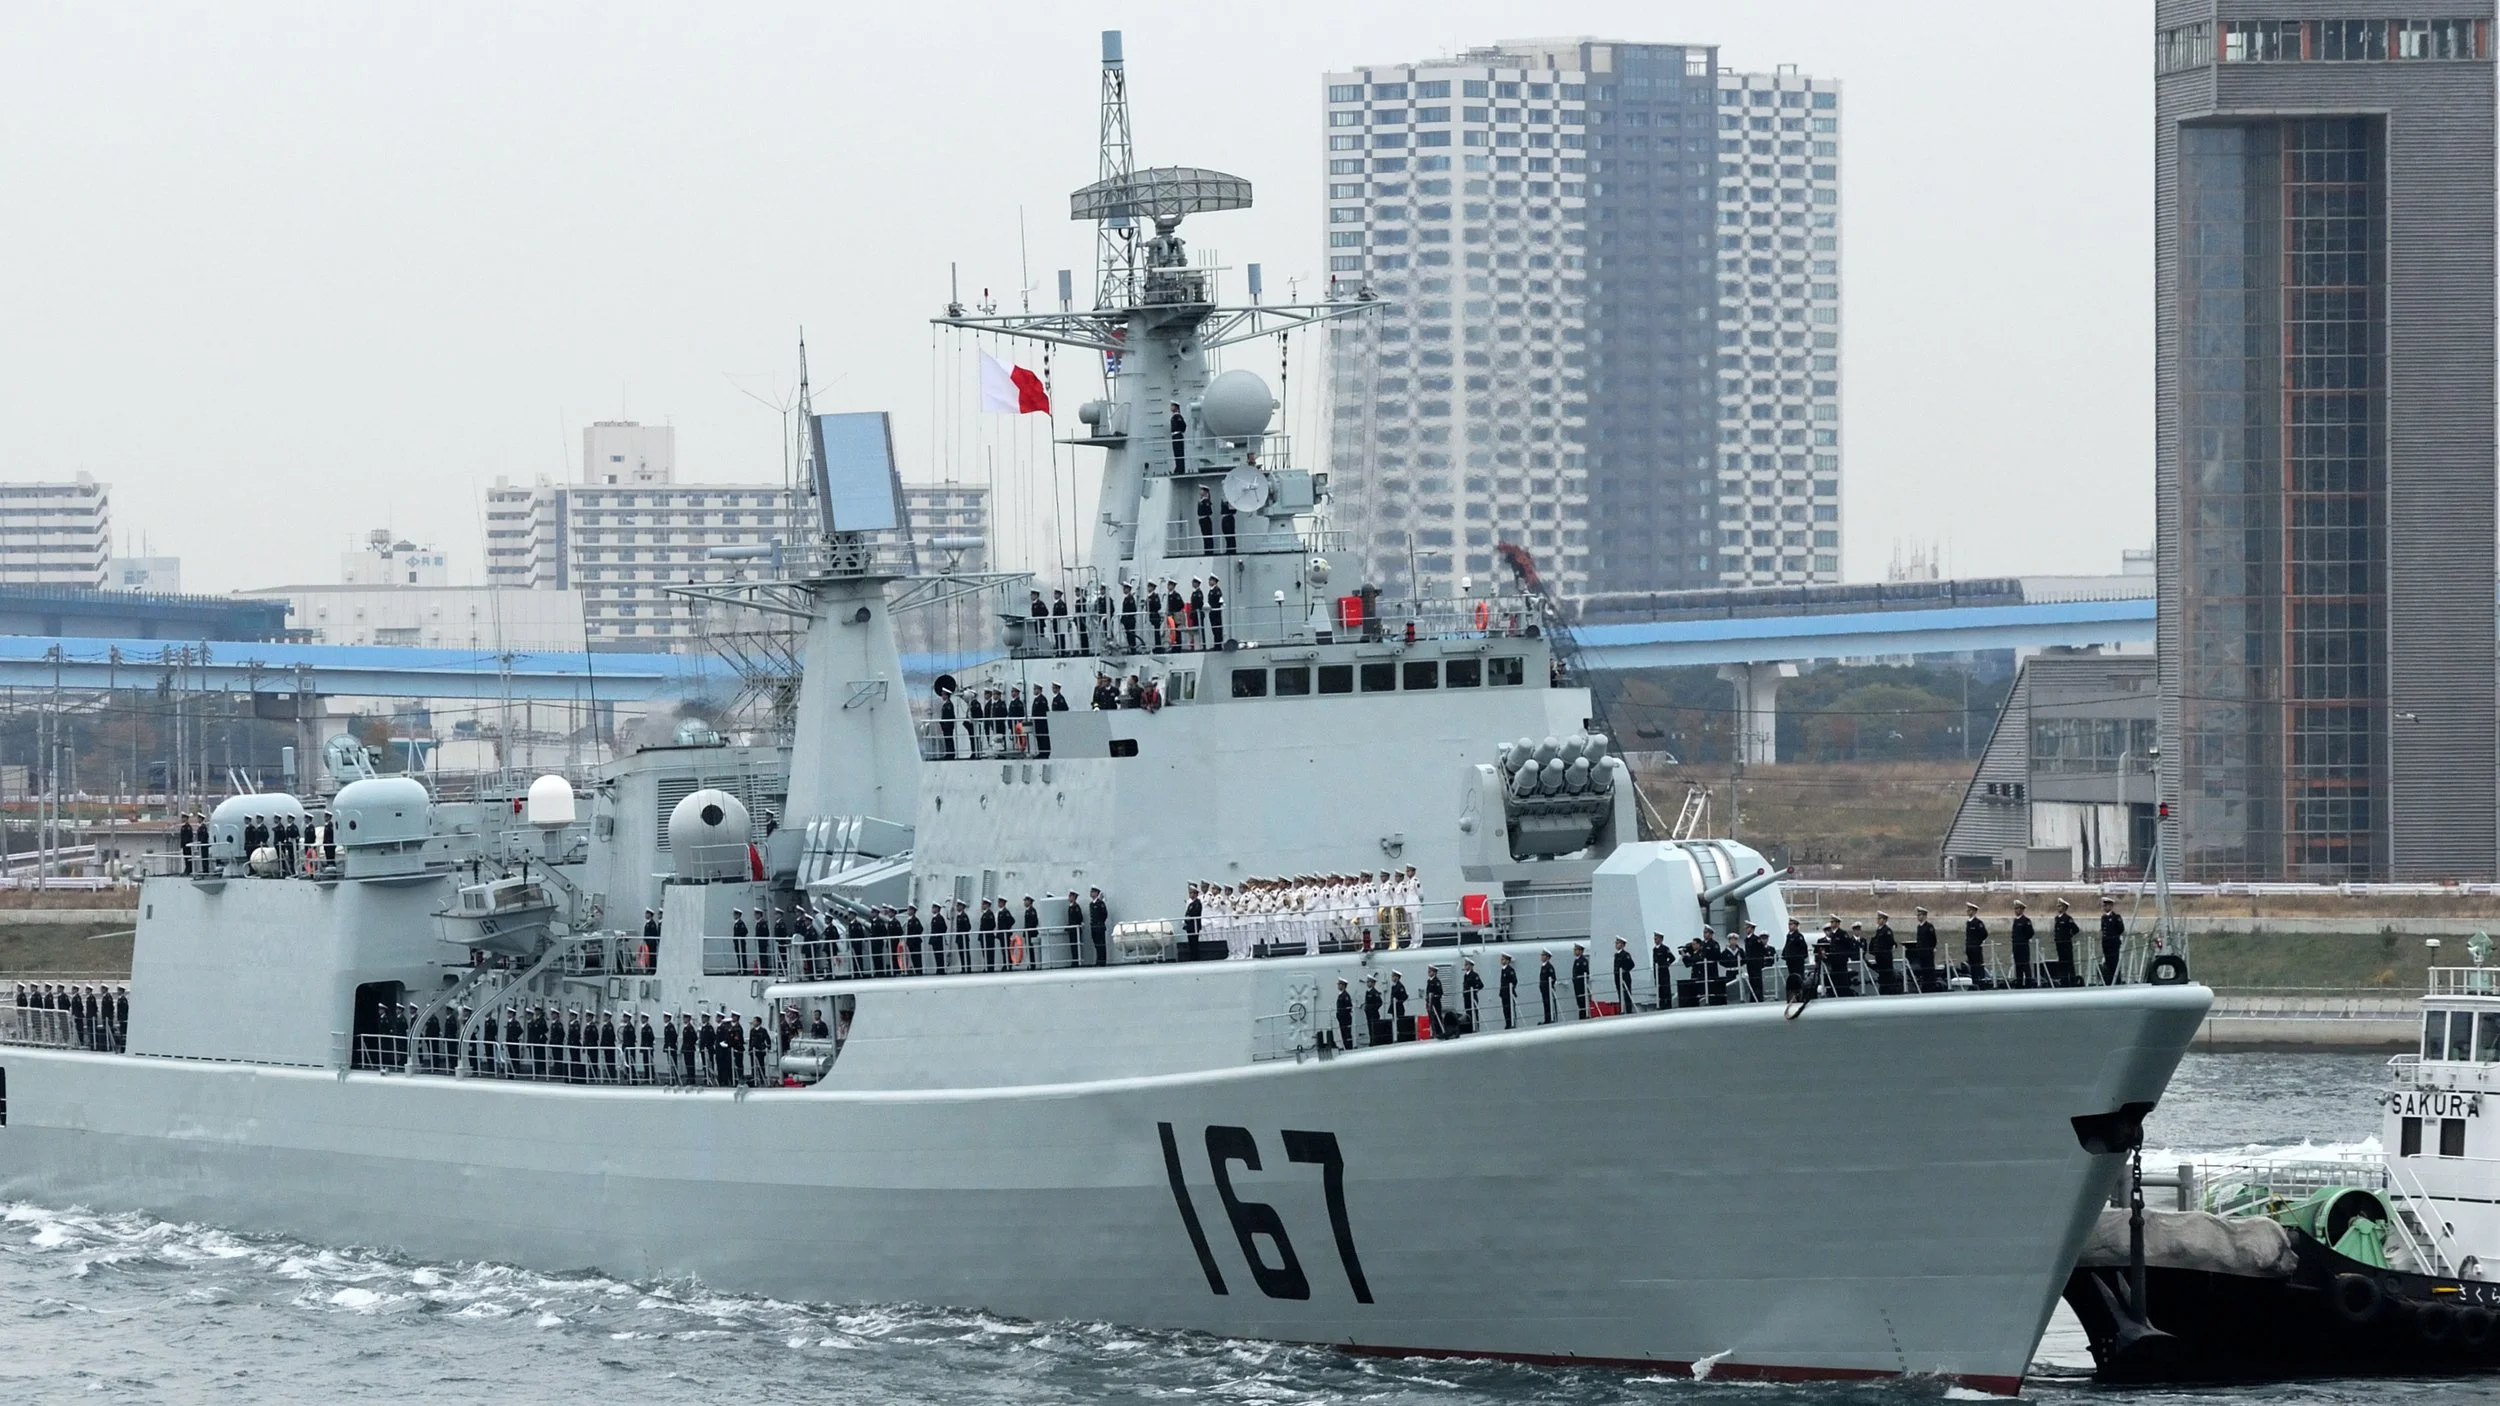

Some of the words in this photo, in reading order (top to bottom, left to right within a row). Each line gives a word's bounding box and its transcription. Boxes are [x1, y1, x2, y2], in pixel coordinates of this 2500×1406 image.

[479, 919, 503, 936] 167
[2391, 1093, 2480, 1118] SAKURA
[1157, 1121, 1375, 1304] 167
